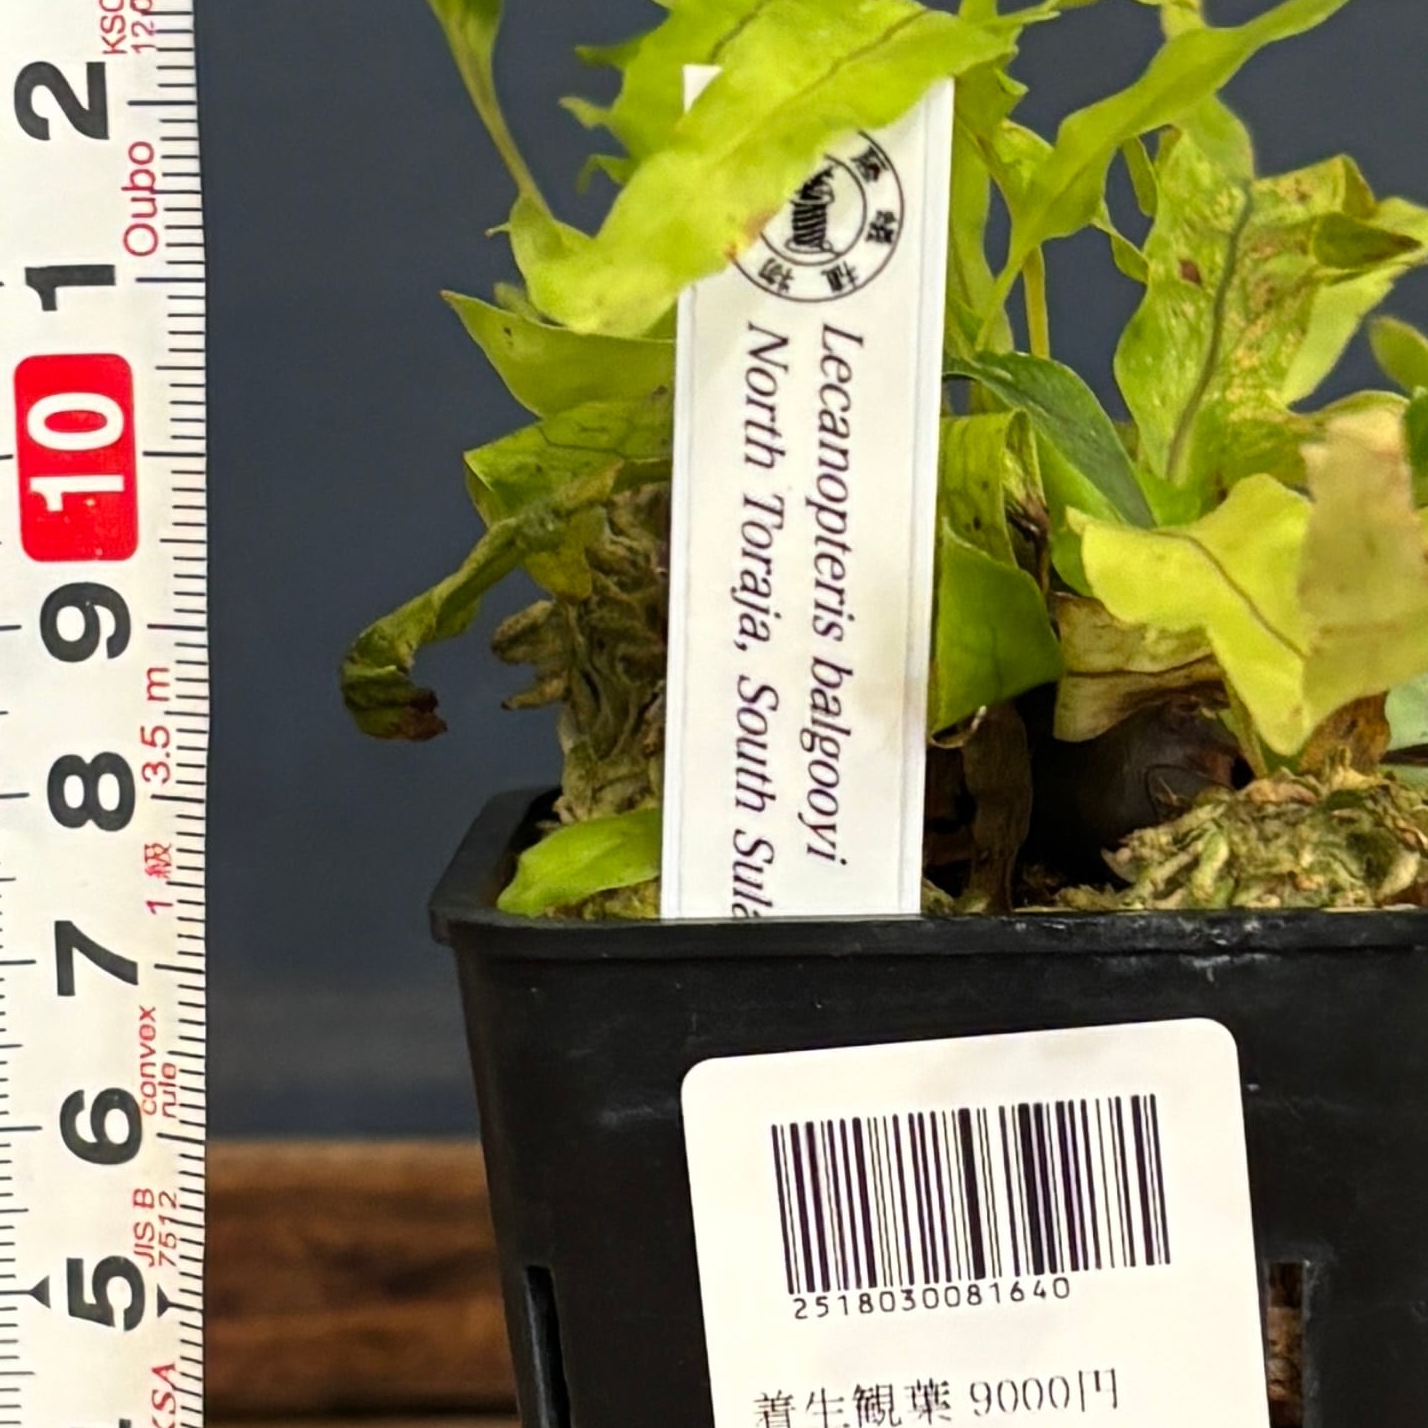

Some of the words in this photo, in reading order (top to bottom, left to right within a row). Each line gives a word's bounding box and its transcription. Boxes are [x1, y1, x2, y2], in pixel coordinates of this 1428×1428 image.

[14, 61, 110, 141] 2
[122, 140, 159, 257] Oubo
[25, 264, 116, 312] 1
[744, 322, 789, 470] North
[27, 392, 125, 512] 10
[805, 322, 865, 643] Lecanopteris
[730, 493, 785, 652] Toraja,
[39, 582, 131, 663] 9
[140, 724, 172, 784] 3.5
[735, 674, 779, 814] South
[797, 656, 855, 866] balgooyi
[47, 751, 136, 832] 8
[54, 920, 139, 997] 7
[59, 1087, 143, 1165] 6
[132, 1188, 156, 1210] B
[132, 1226, 157, 1268] JIS
[66, 1255, 146, 1332] 5
[793, 1276, 1071, 1320] 2518030081640
